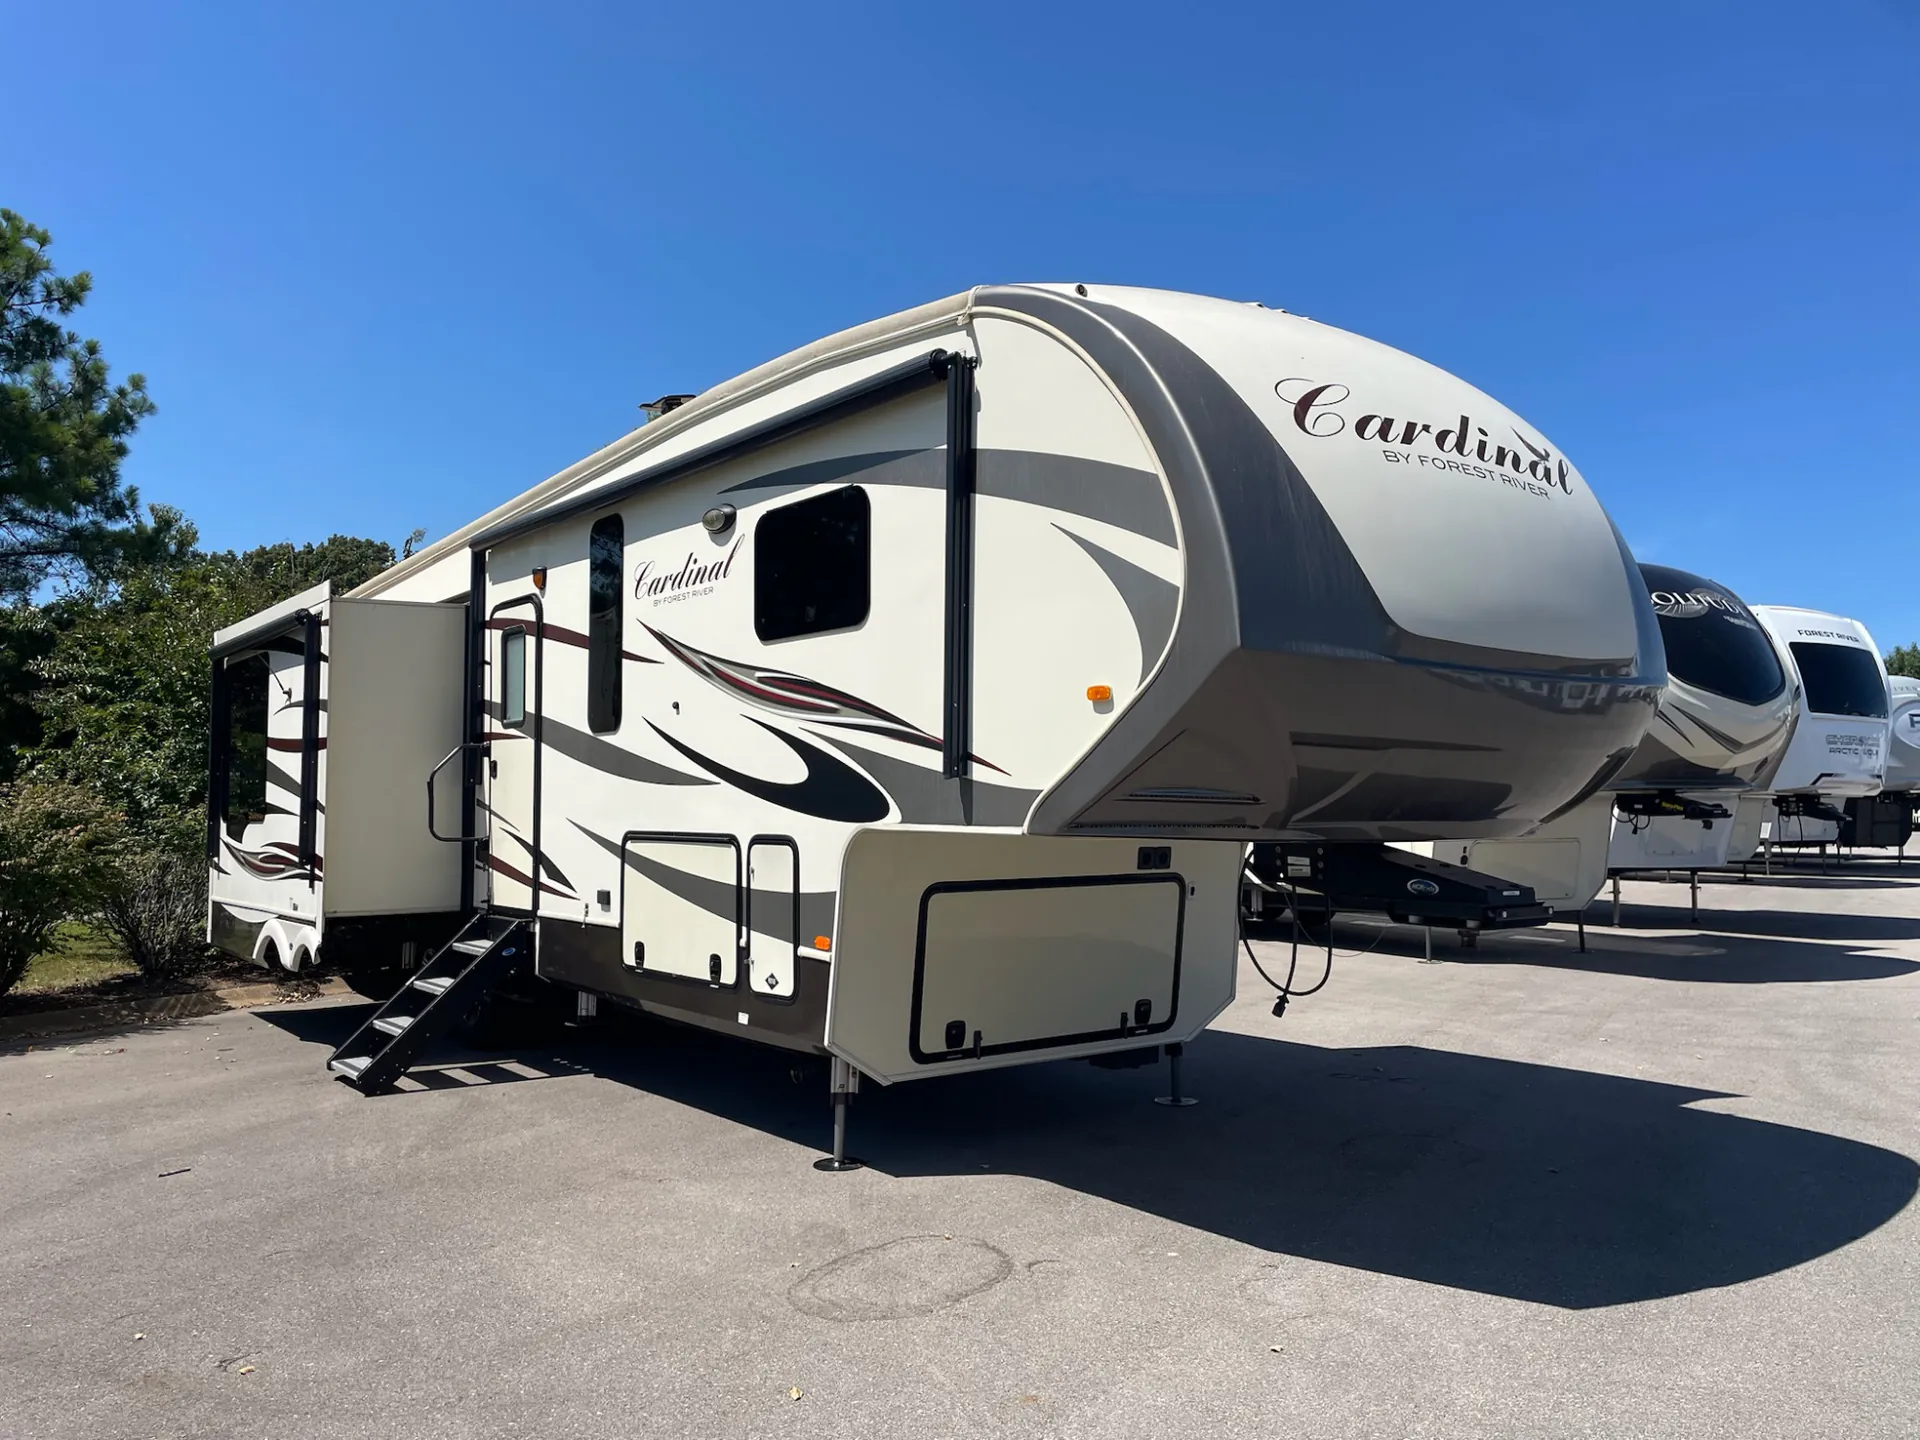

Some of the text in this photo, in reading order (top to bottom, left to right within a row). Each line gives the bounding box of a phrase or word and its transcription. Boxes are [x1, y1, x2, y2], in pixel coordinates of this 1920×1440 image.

[1274, 377, 1573, 495] Cardinal
[1382, 450, 1550, 499] BY FOREST RIVER
[634, 533, 745, 600] Cardinal
[653, 586, 713, 607] BY FOREST RIVER
[1797, 629, 1834, 638] FOREST
